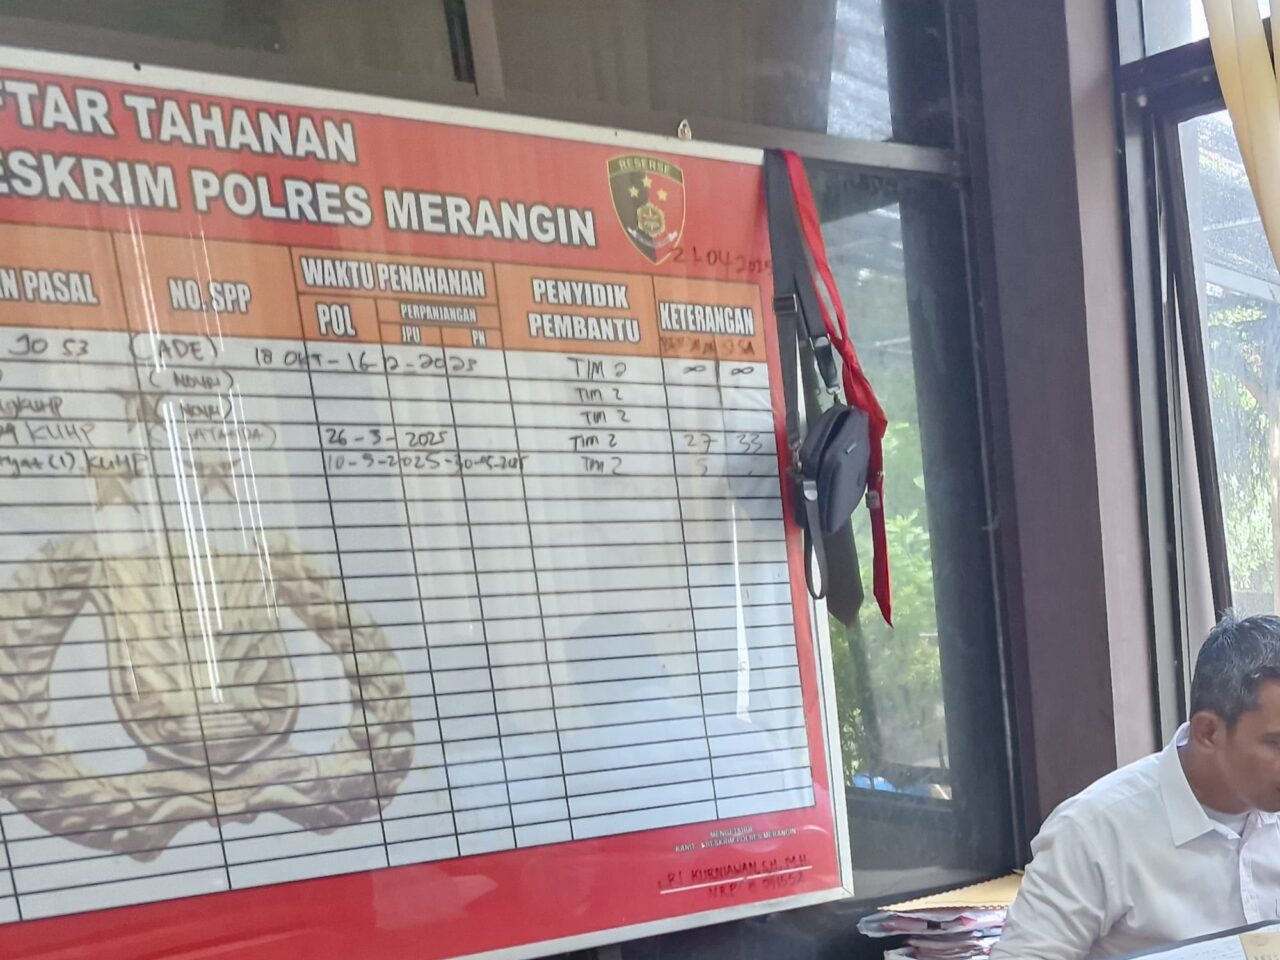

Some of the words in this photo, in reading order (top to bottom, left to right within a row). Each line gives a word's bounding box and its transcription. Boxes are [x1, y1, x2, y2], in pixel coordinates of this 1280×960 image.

[0, 79, 117, 137] TAR
[123, 94, 358, 164] TAHANAN
[0, 147, 180, 211] SKRIM
[190, 167, 373, 228] POLRES
[383, 187, 597, 248] MERANGIN
[21, 269, 100, 305] PASAL
[300, 255, 374, 290] WAKTU
[377, 262, 486, 298] PENAHANAN
[531, 277, 629, 310] PENYIDIK
[316, 302, 357, 338] POL
[400, 302, 477, 324] PERPANJANGAN
[527, 312, 642, 345] PEMBANTU
[658, 302, 755, 337] KETERANGAN
[401, 325, 421, 344] JPU
[471, 329, 486, 347] PN
